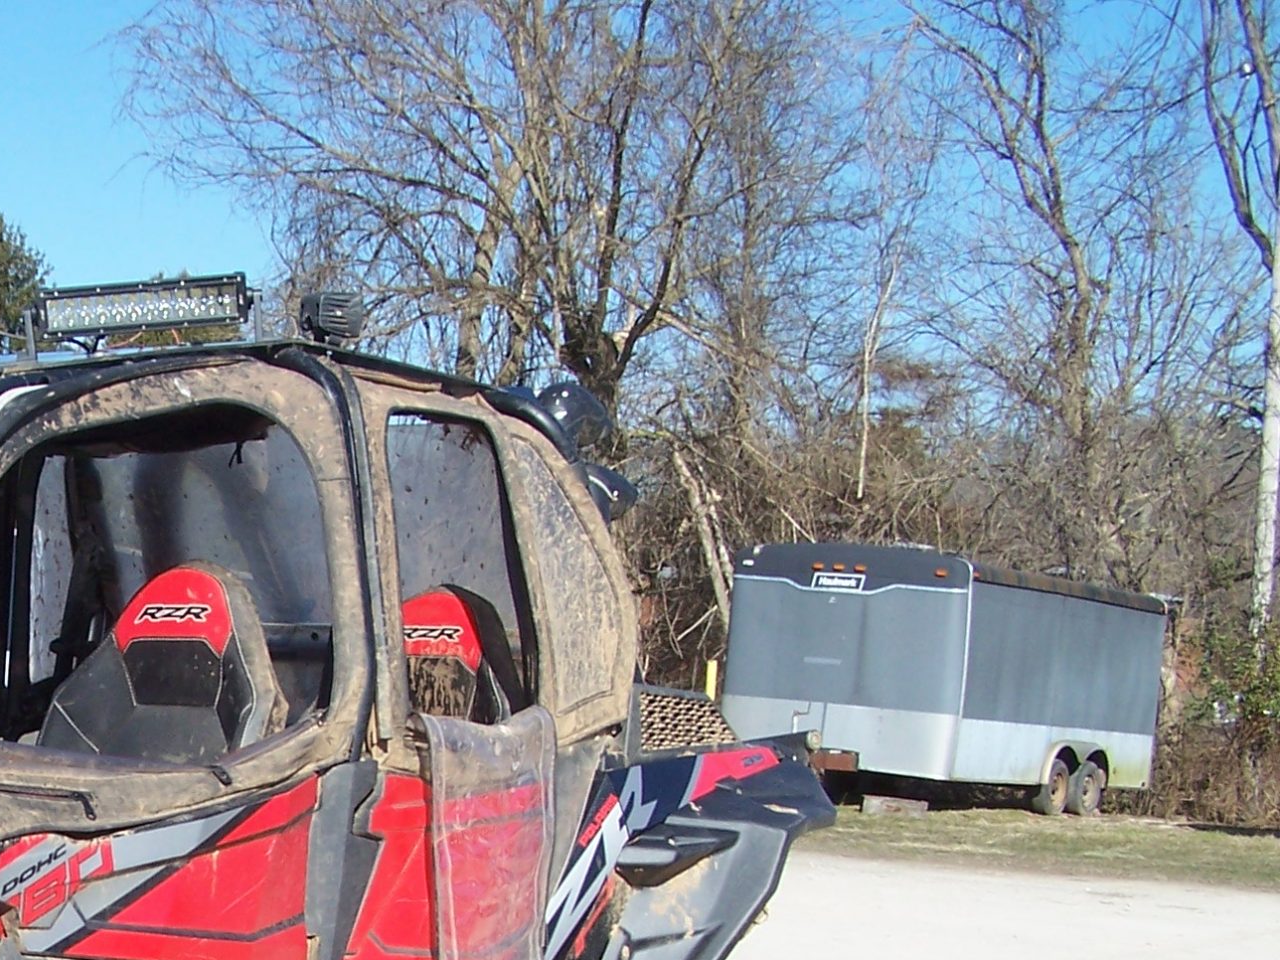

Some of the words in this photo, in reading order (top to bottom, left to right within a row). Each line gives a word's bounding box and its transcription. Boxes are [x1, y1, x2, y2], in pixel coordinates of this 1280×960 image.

[134, 604, 212, 624] RZR
[577, 793, 618, 848] POLARIS
[1, 843, 68, 896] DOHC
